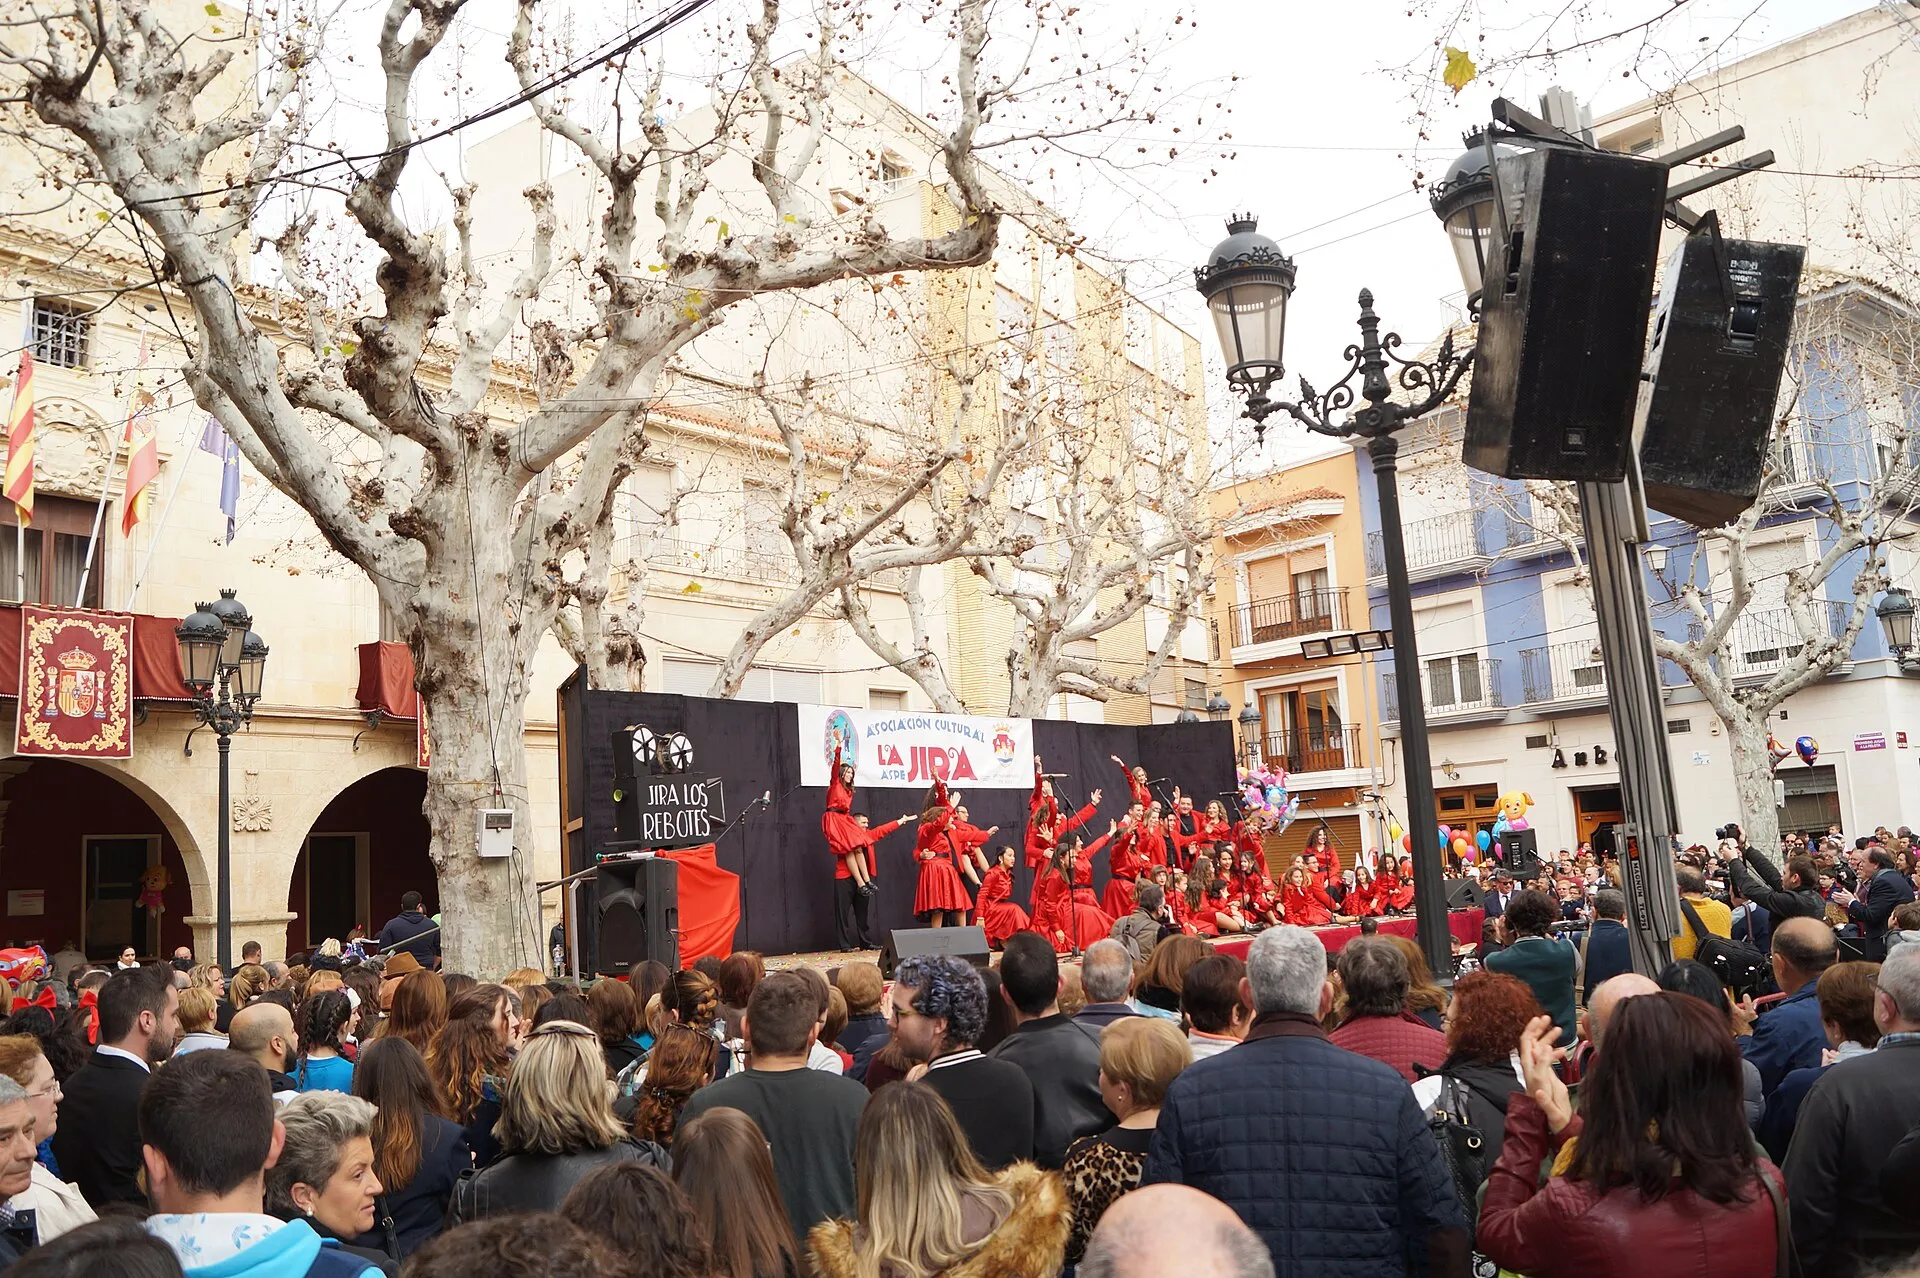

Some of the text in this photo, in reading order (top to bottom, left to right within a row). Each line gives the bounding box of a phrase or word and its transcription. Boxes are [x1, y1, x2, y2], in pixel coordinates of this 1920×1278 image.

[866, 715, 985, 743] ASOCIACIÓN CULTURAL
[877, 743, 904, 766] LA
[907, 745, 978, 783] JIRA
[880, 769, 906, 781] ASPE
[647, 782, 709, 808] JIRA LOS
[642, 808, 711, 841] REBOTES
[1633, 861, 1644, 898] MAGNUM
